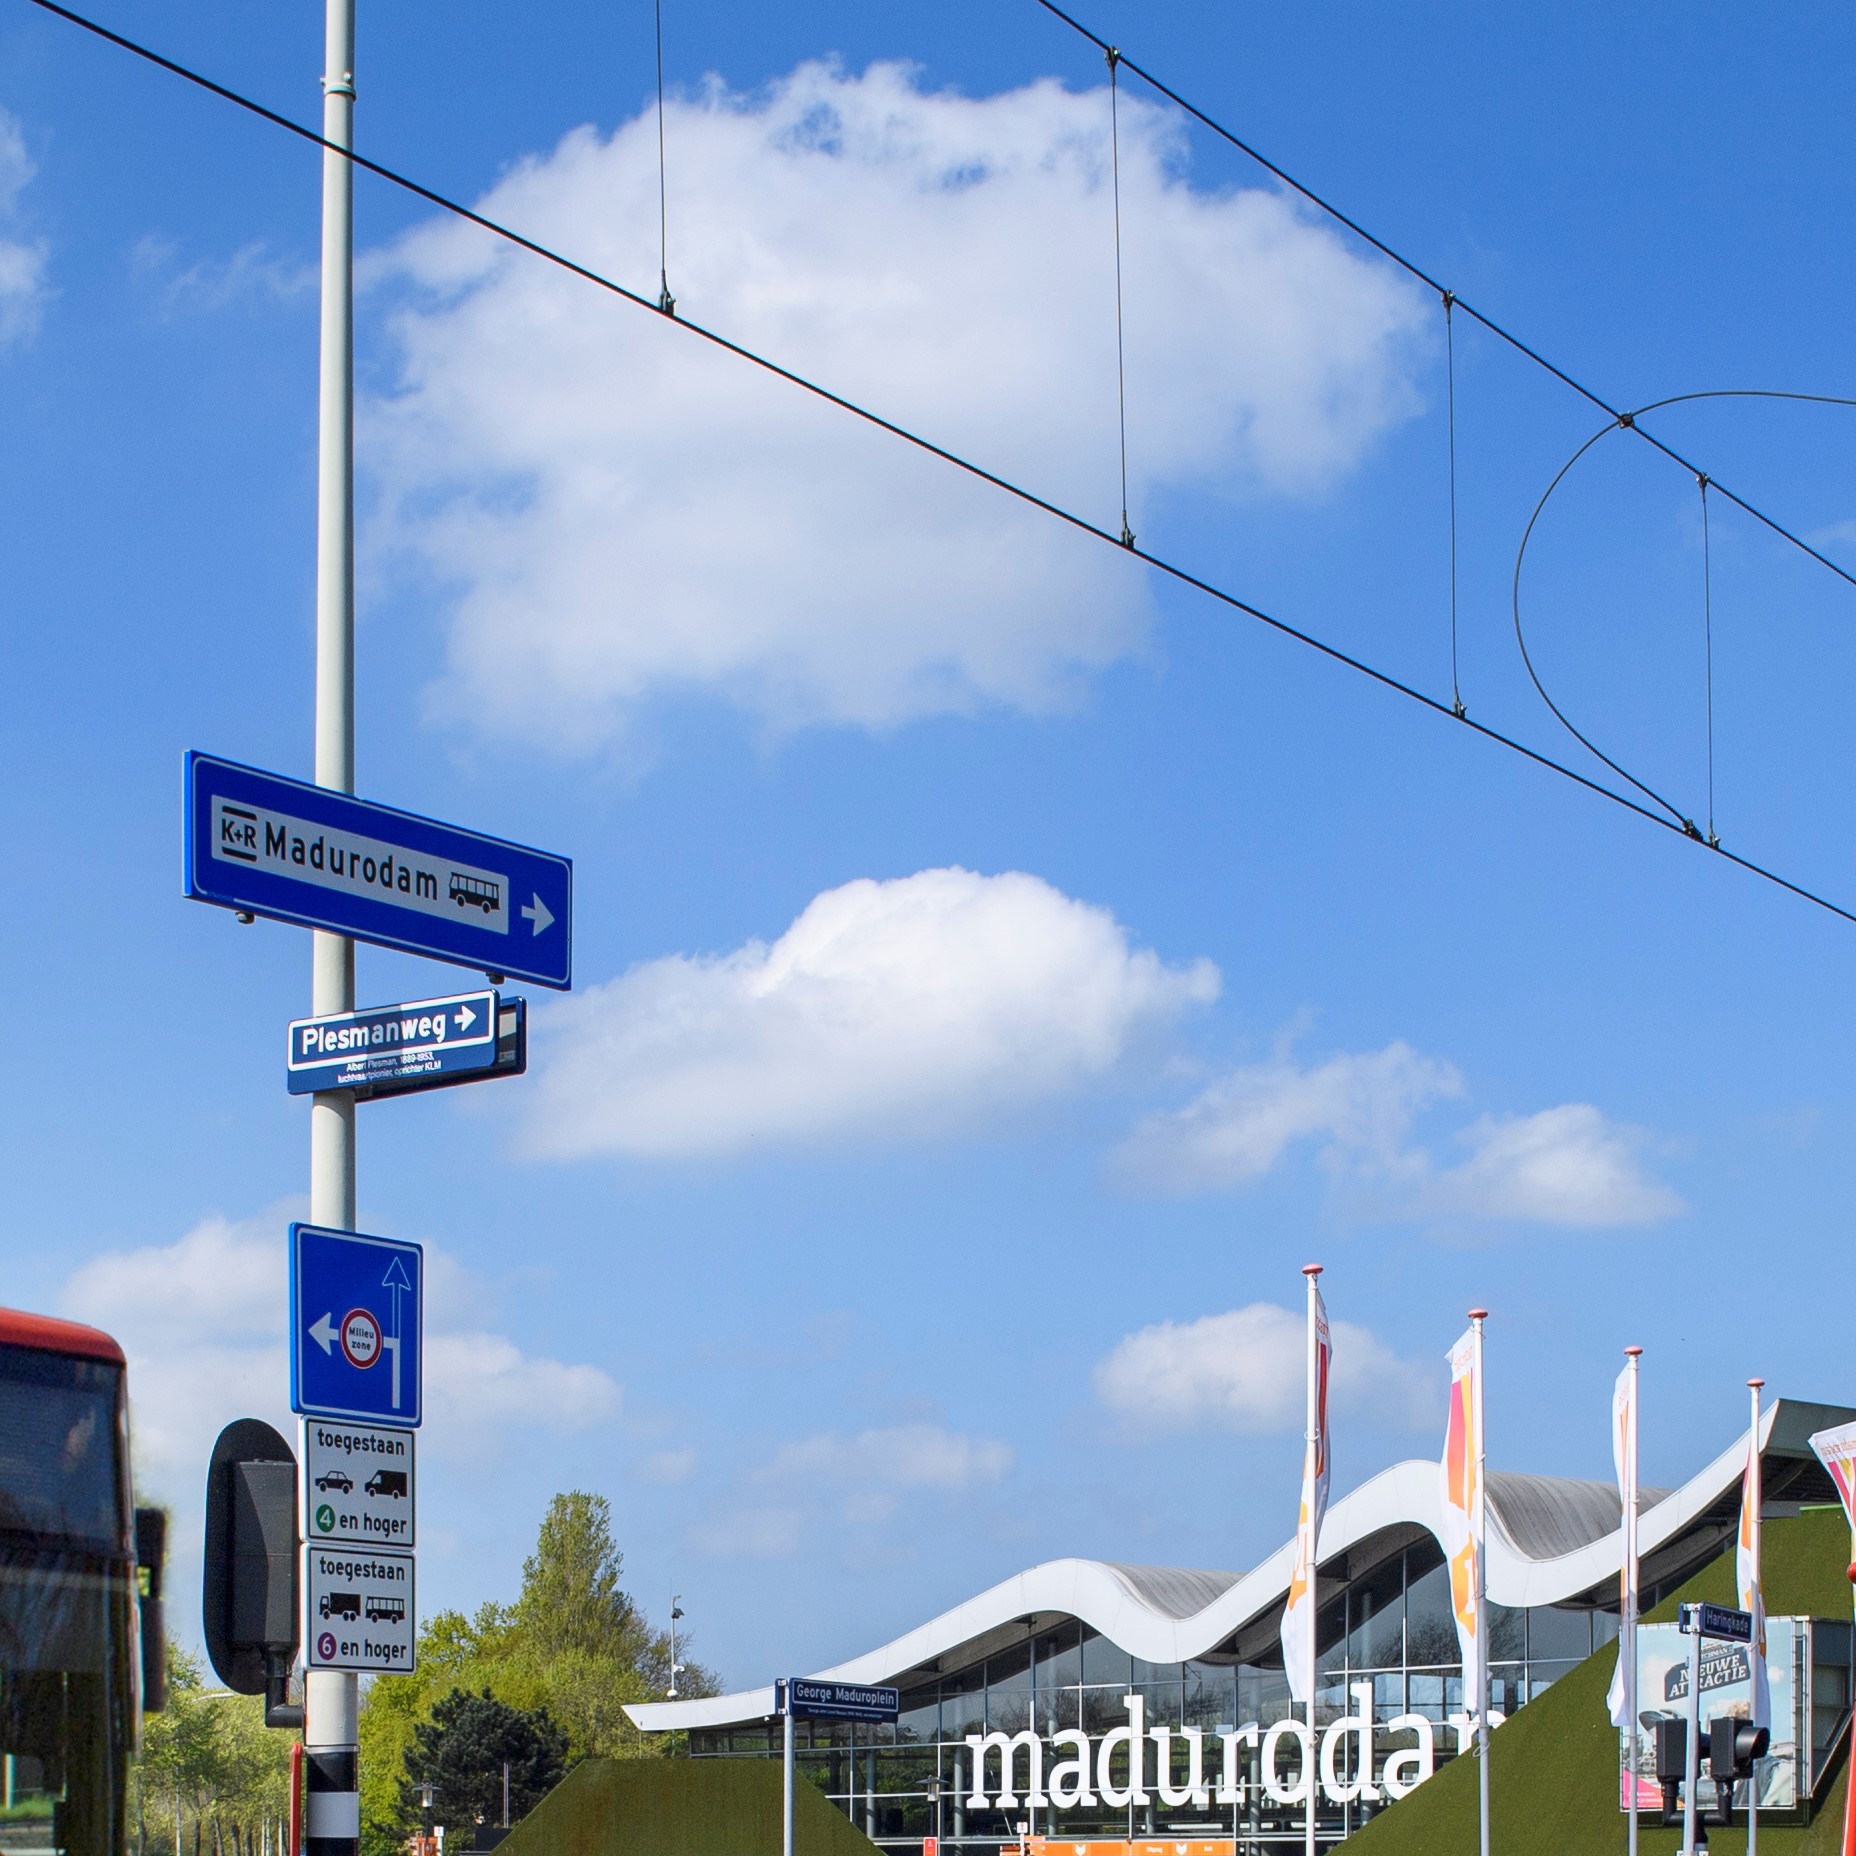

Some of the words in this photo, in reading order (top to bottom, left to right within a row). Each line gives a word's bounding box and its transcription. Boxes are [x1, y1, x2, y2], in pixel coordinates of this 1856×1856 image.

[265, 821, 438, 901] Madurodam
[302, 1013, 447, 1055] Plesmanweg
[348, 1326, 375, 1339] Milieu
[351, 1341, 371, 1351] zone
[317, 1428, 405, 1456] toegestaan
[319, 1509, 333, 1527] 4
[339, 1514, 359, 1530] en
[363, 1512, 407, 1538] hoger
[319, 1556, 405, 1583] toegestaan
[1706, 1609, 1749, 1633] Haringkade
[322, 1636, 332, 1655] 6
[340, 1641, 359, 1657] en
[364, 1639, 407, 1664] hoger
[1668, 1665, 1747, 1697] ATRACTIE
[1679, 1654, 1740, 1682] NEUWE
[796, 1684, 832, 1702] George
[835, 1687, 895, 1705] Maduroplein
